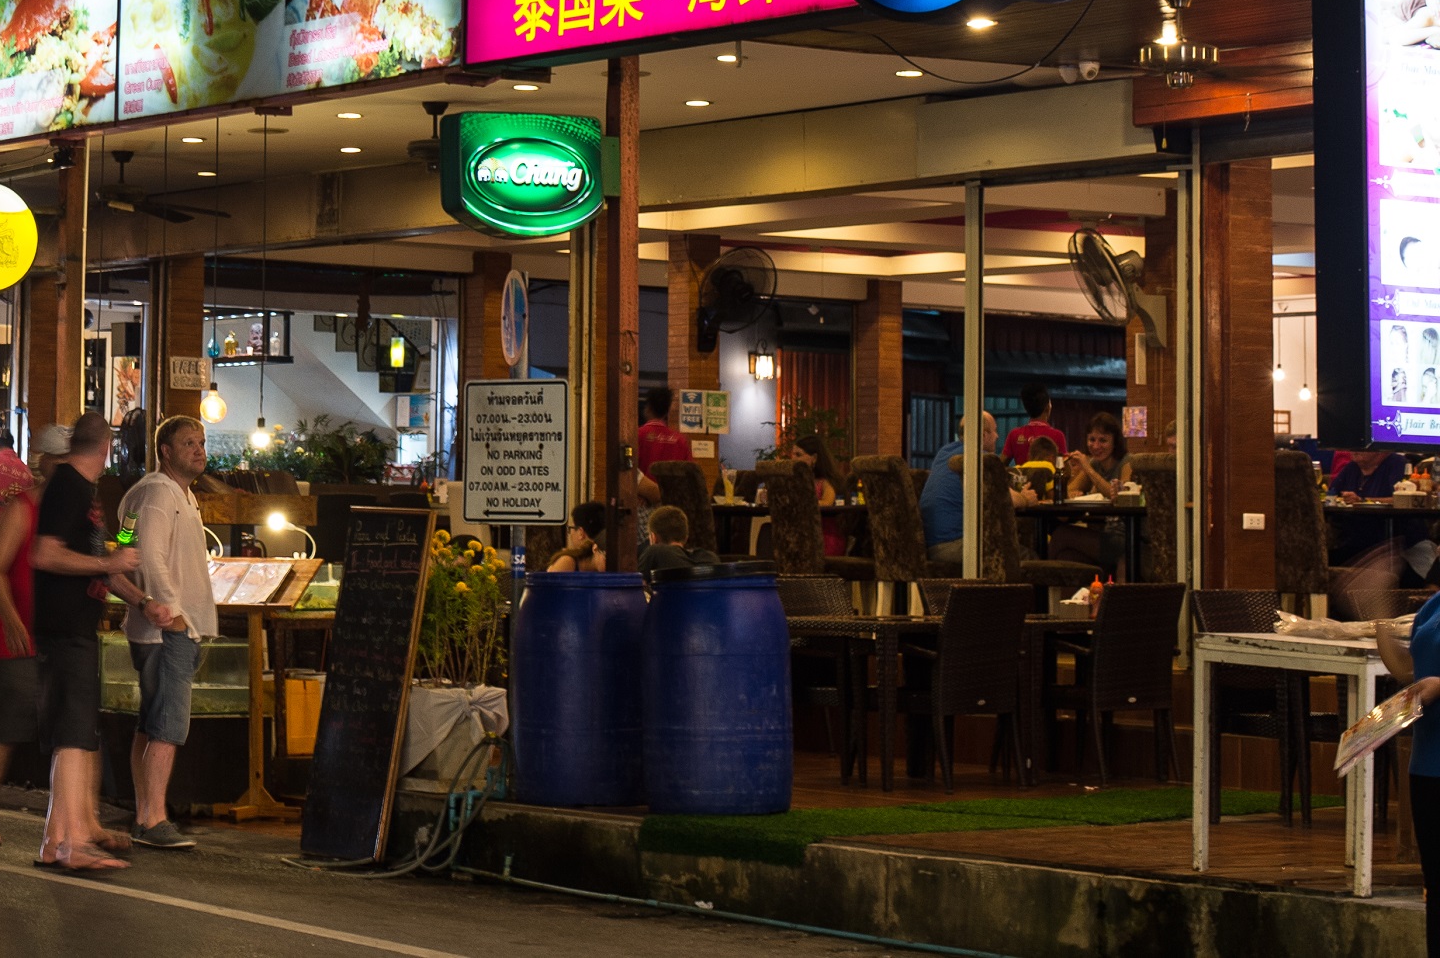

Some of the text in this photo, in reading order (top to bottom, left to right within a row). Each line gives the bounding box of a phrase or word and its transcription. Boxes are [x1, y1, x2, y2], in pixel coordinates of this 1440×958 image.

[124, 81, 145, 94] Green
[510, 158, 583, 192] Chang
[1404, 418, 1425, 431] Hair
[487, 450, 543, 460] NO PARKING
[480, 466, 550, 476] ON ODD DATES
[486, 498, 542, 508] NO HOLIDAY
